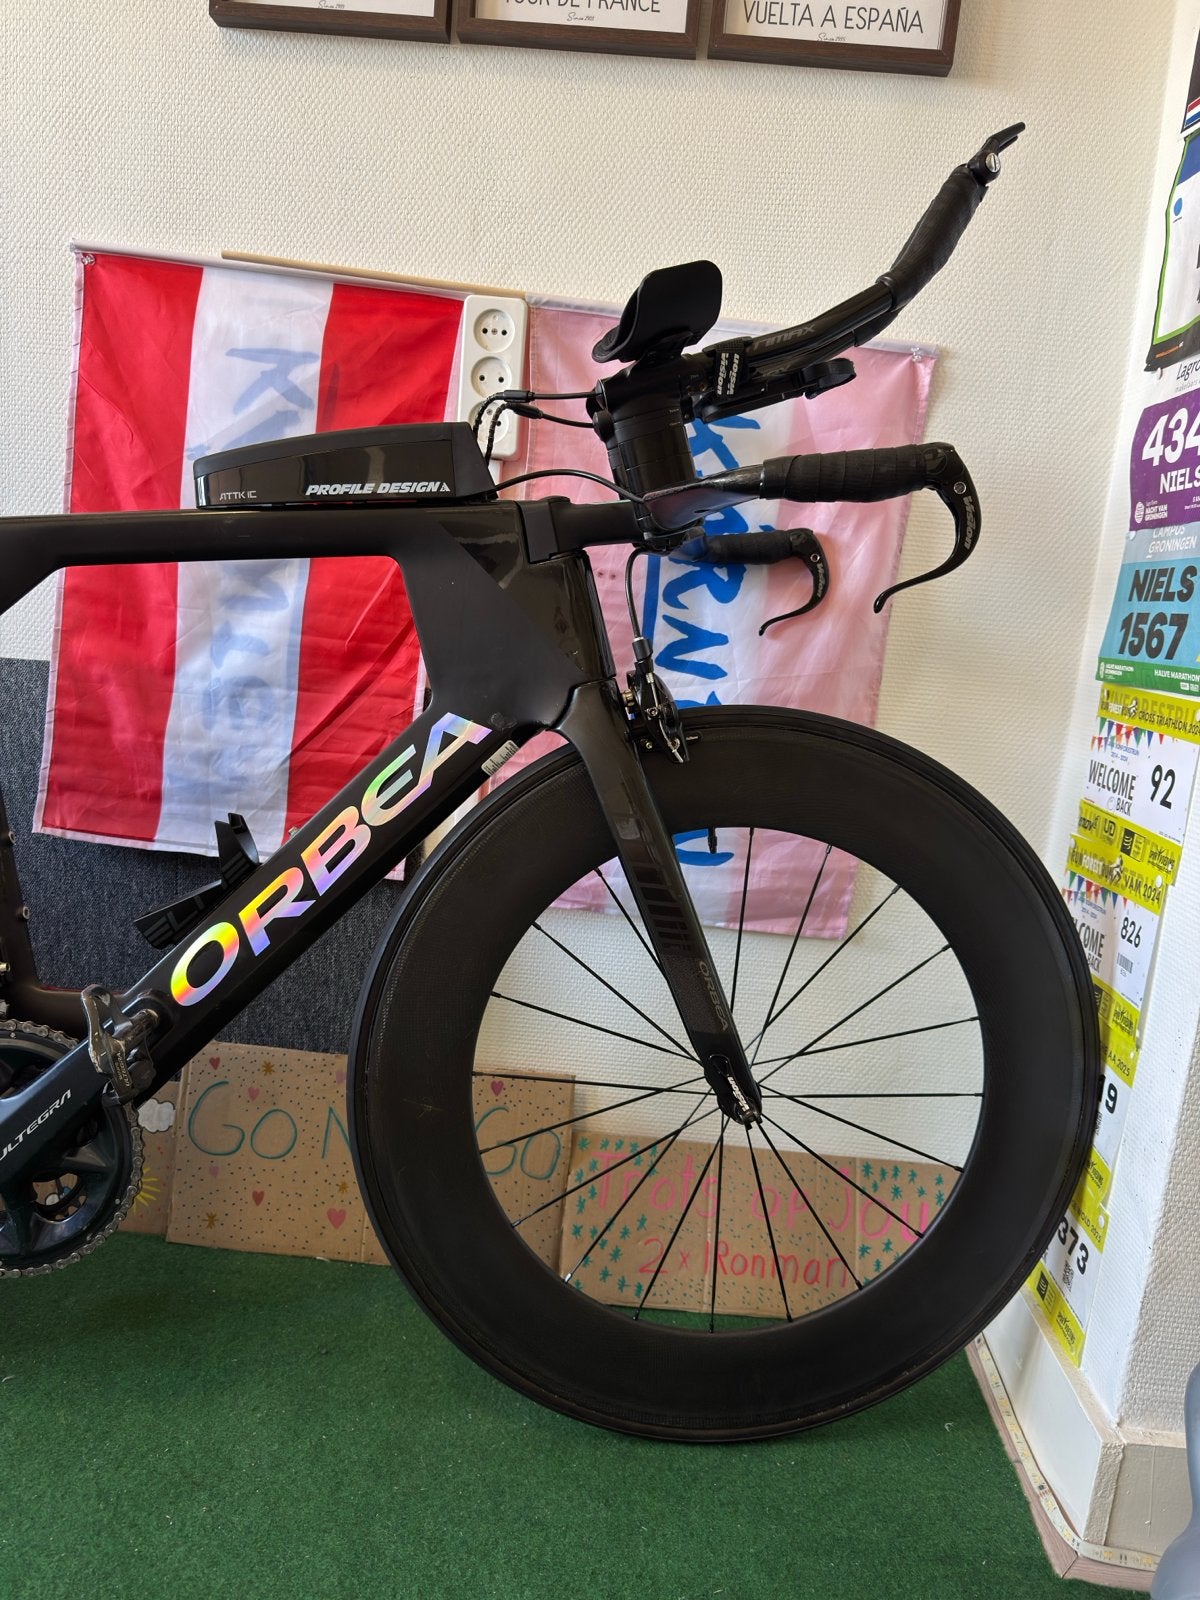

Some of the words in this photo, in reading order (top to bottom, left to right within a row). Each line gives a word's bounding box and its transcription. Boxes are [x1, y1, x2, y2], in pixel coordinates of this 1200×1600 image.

[743, 0, 813, 27] VUELTA
[821, 5, 837, 28] A
[844, 6, 923, 33] ESPAÑA
[305, 482, 375, 496] PROFILE
[376, 481, 441, 494] DESIGN
[1160, 465, 1200, 494] NIELS
[1148, 536, 1198, 554] GRONINGEN
[1127, 565, 1198, 603] NIELS
[1118, 611, 1189, 660] 1567
[1154, 669, 1170, 678] HALVE
[1088, 759, 1136, 801] WELCOME
[1150, 765, 1176, 809] 92
[1116, 797, 1132, 816] BACK
[170, 712, 493, 1007] ORBEA
[1143, 883, 1162, 903] 2024
[1120, 916, 1142, 948] 826
[700, 960, 729, 1032] ORBEA
[592, 1151, 719, 1218] Trots
[752, 1186, 811, 1229] op
[638, 1238, 668, 1274] 2
[1058, 1216, 1089, 1275] 373
